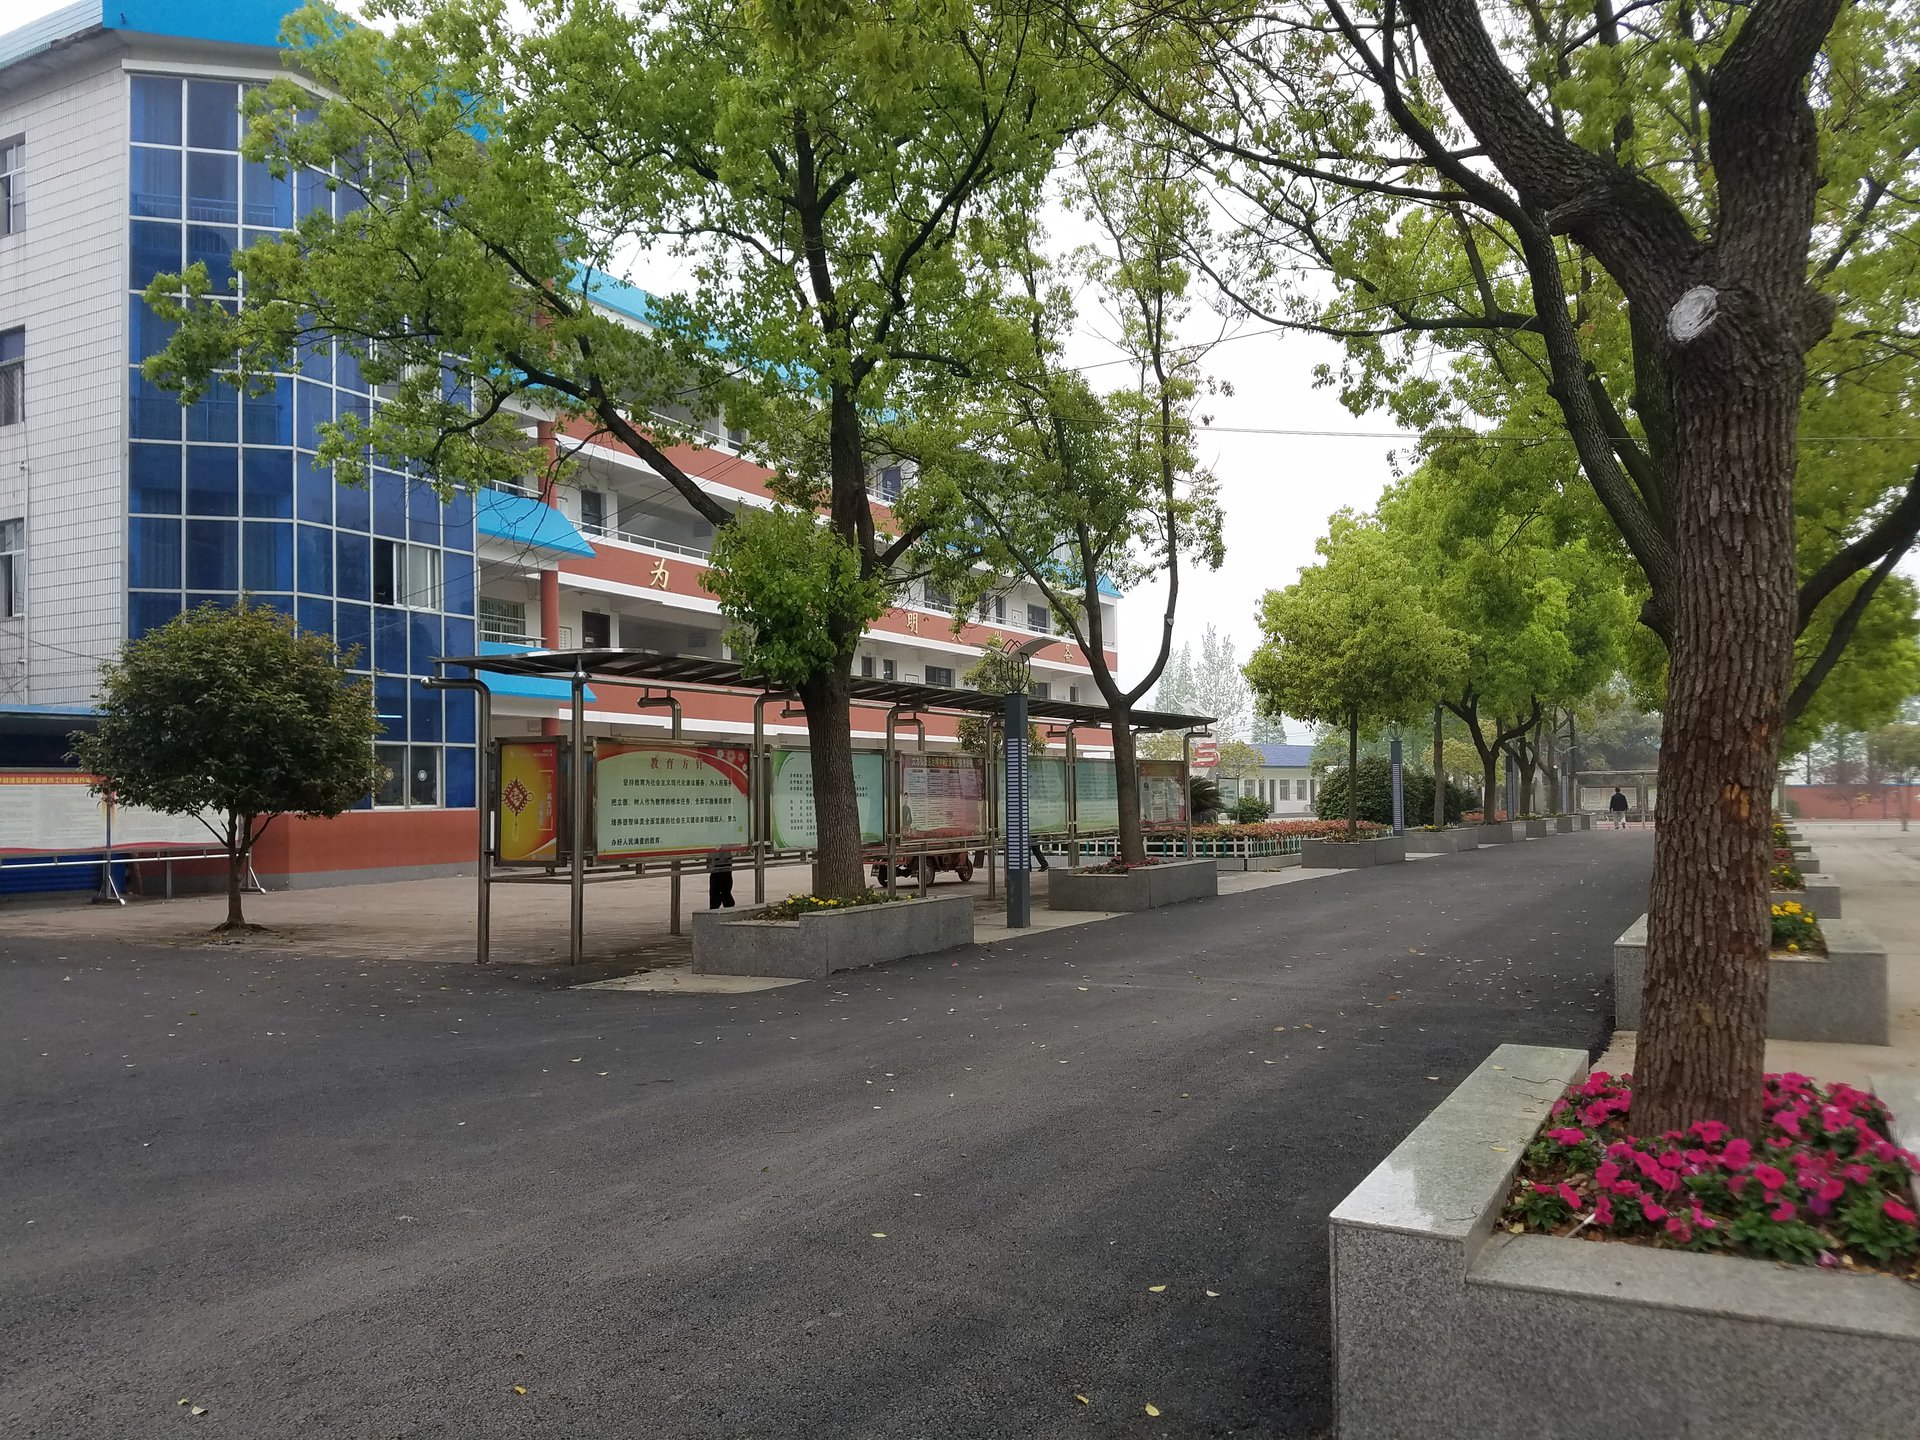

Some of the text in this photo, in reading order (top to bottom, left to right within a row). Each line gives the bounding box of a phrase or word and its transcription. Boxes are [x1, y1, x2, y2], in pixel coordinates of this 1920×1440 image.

[649, 557, 670, 590] 为
[906, 612, 918, 634] 明
[650, 755, 704, 770] 教育方针
